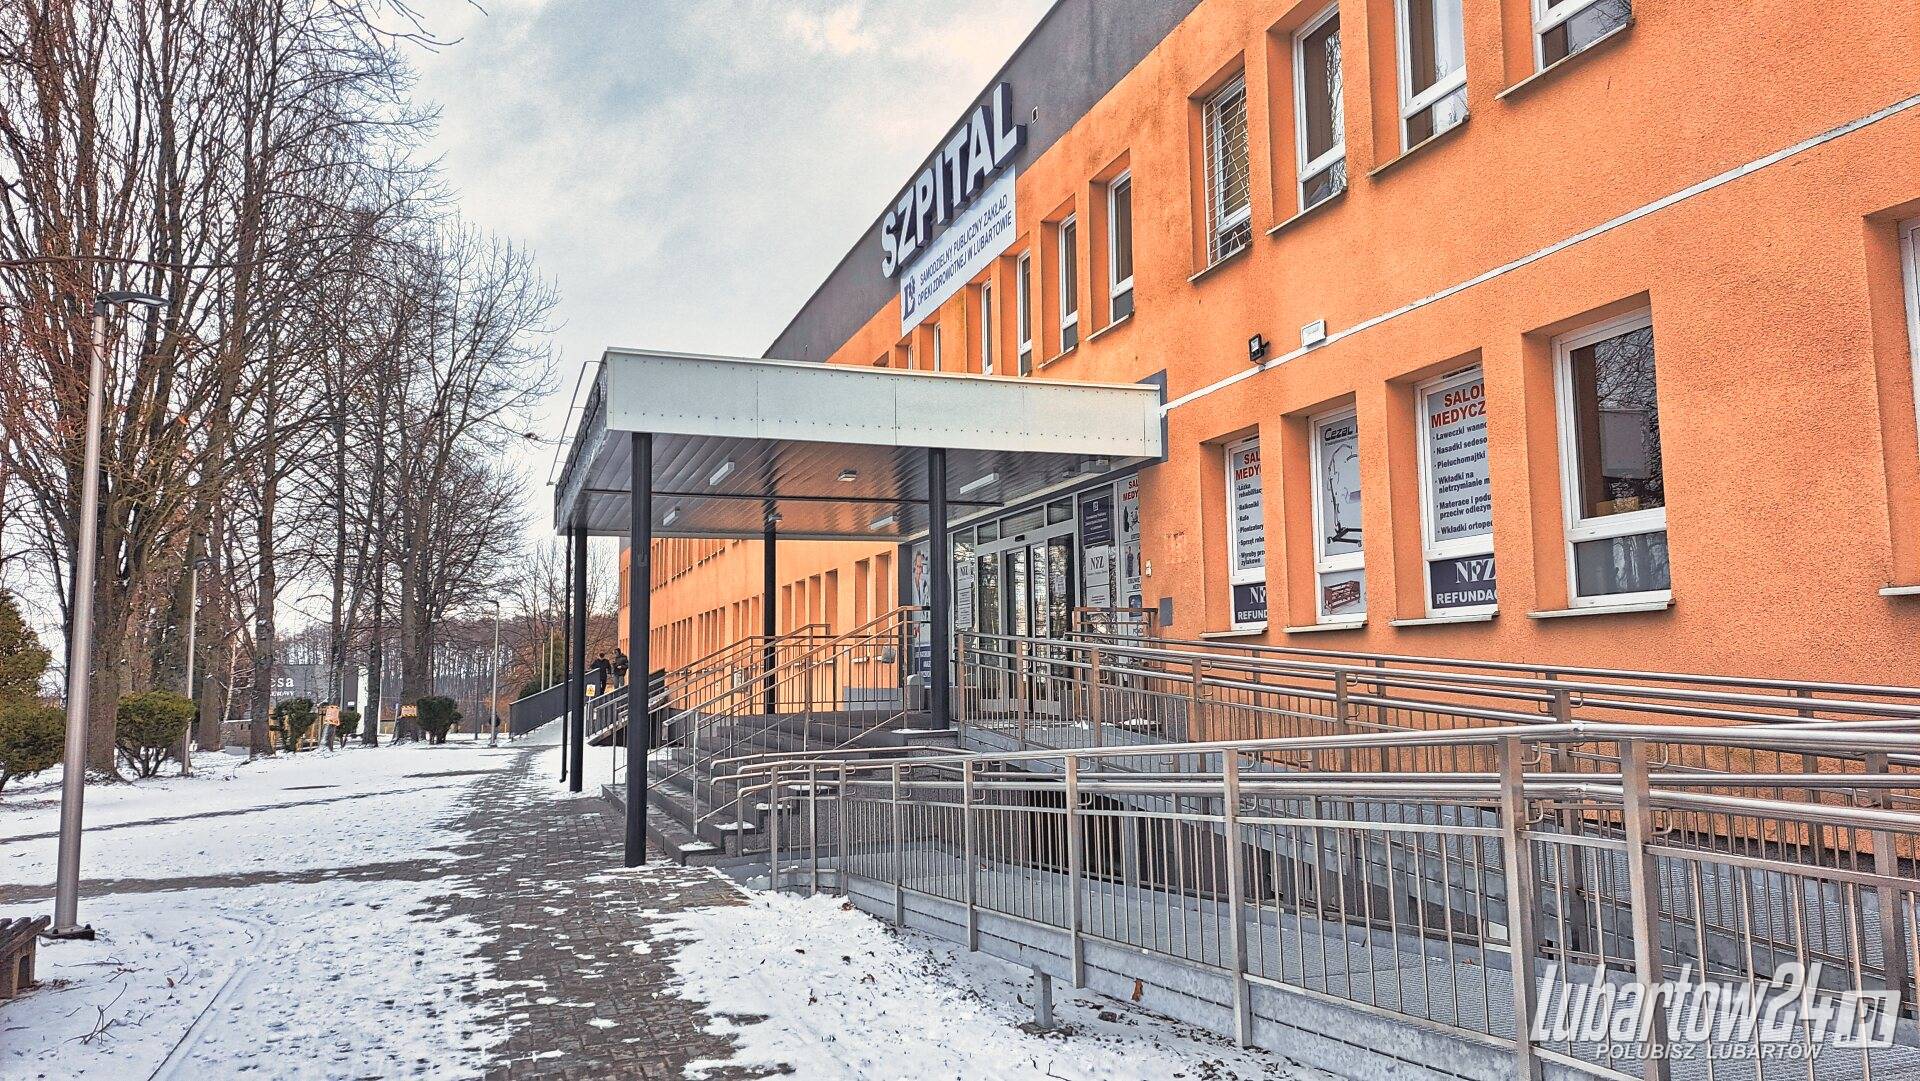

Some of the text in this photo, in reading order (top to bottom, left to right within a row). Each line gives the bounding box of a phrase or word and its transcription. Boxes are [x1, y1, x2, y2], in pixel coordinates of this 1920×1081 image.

[881, 82, 1020, 279] SZPITAL
[920, 194, 1008, 286] SAMODZIELNY PUBLICZNY ZAKŁAD
[917, 210, 1012, 306] OPIEKI ZDROWOTNEJ W LUBARTOWIE
[1431, 400, 1487, 429] MEDYCZ
[1436, 436, 1488, 455] Nasadki sedeso
[1437, 450, 1486, 469] Pieluchomajtki
[1236, 464, 1261, 480] MEDY
[1465, 471, 1474, 479] na
[1439, 497, 1469, 510] Materace
[1440, 508, 1464, 520] przeciw
[1090, 555, 1104, 570] NFZ
[1455, 558, 1496, 584] NFZ
